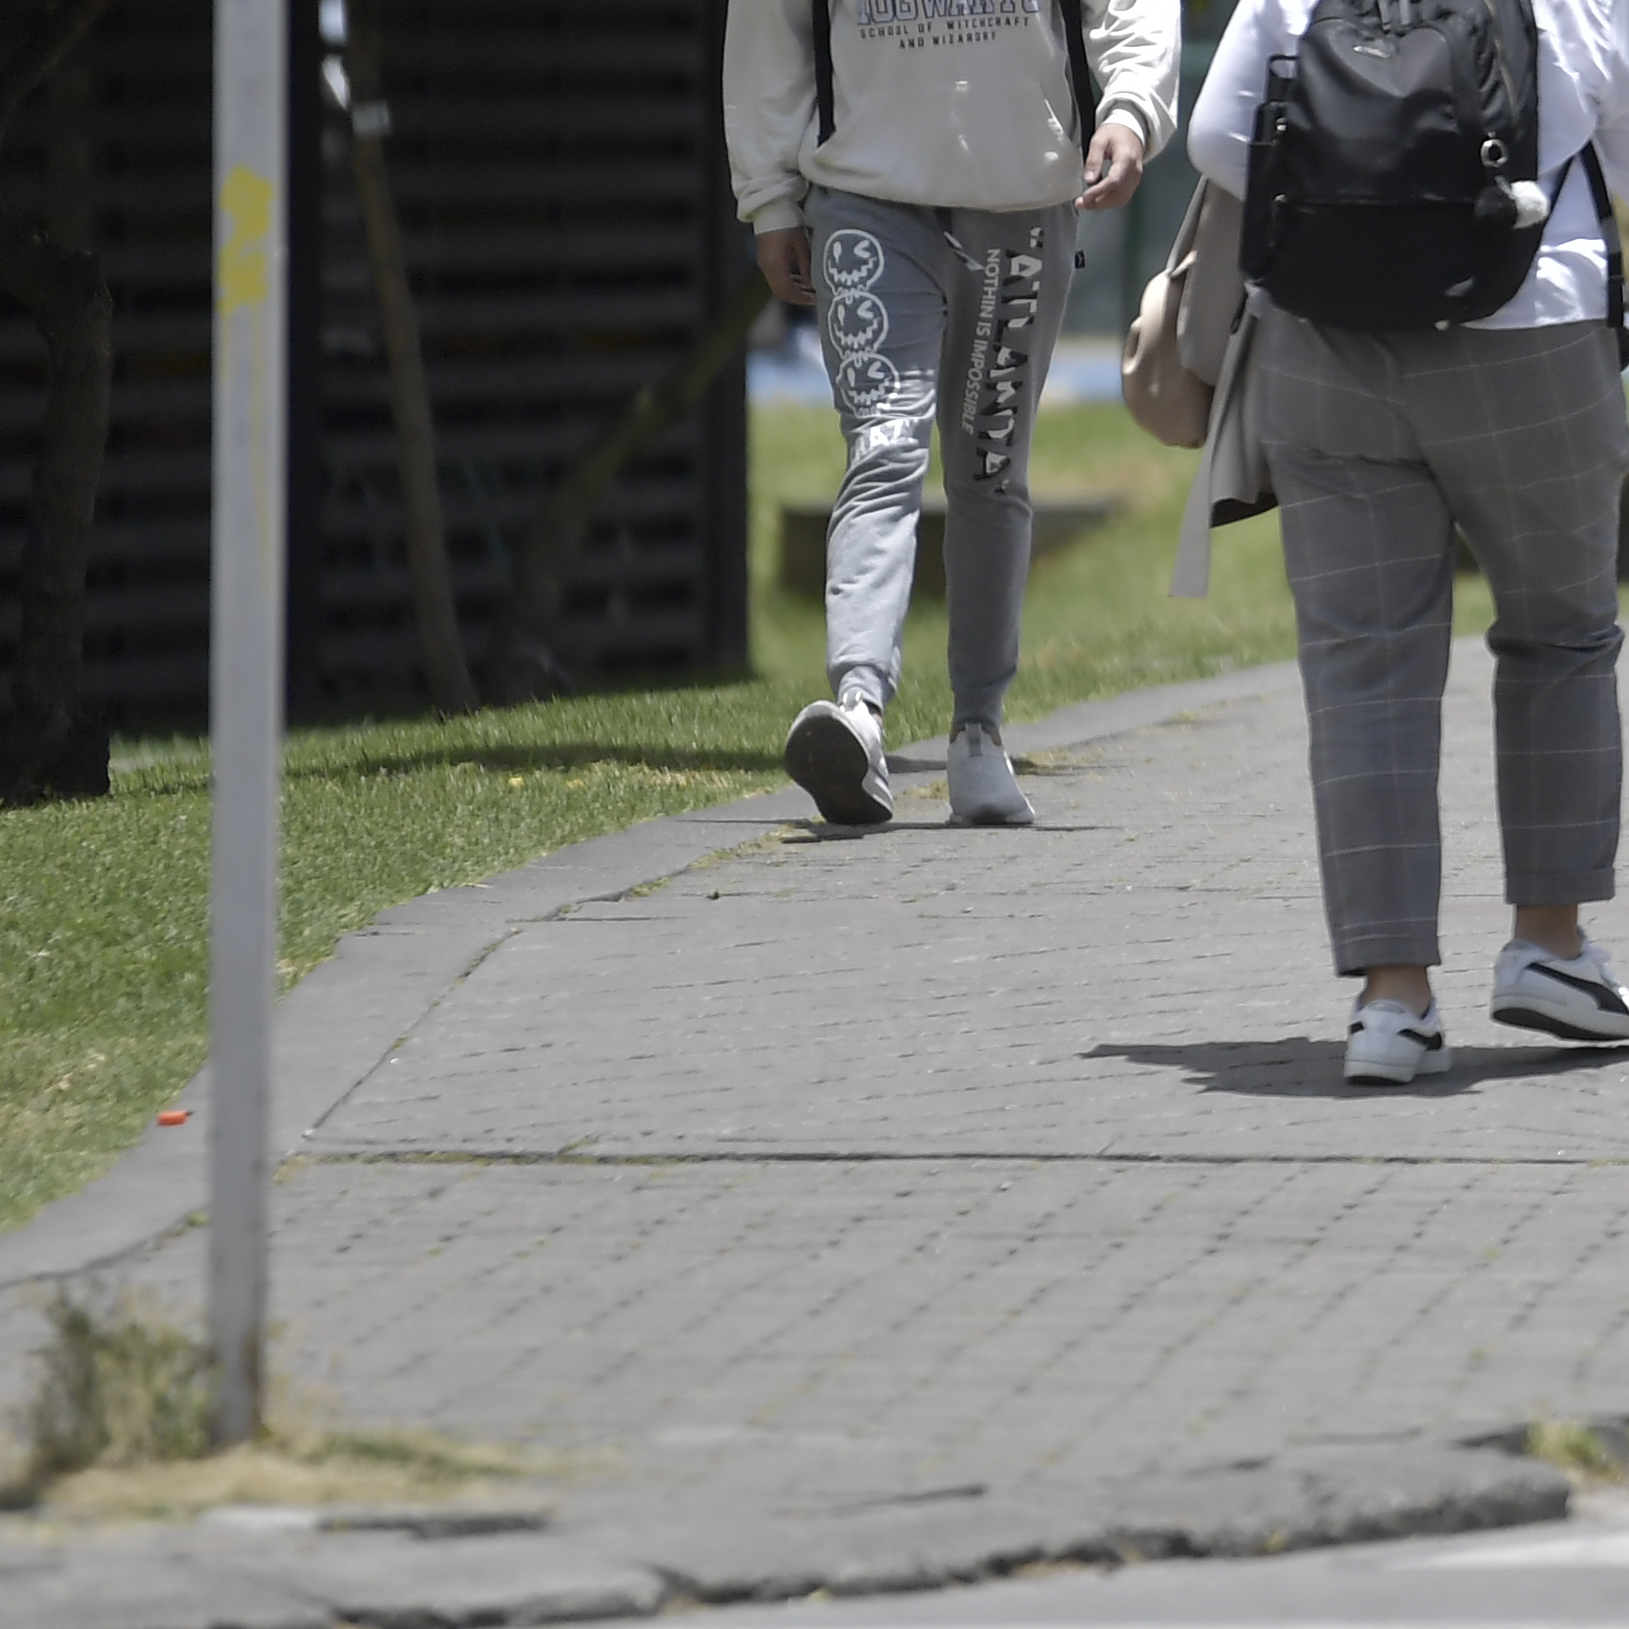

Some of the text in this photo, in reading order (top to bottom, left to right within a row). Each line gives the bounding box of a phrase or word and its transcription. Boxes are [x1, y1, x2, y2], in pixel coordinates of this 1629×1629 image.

[859, 16, 1030, 39] SCHOOL OF WITCHCRAFT
[898, 30, 997, 49] AND WIZARDRY
[960, 248, 1001, 436] NOTHIN IS IMPOSSIBLE
